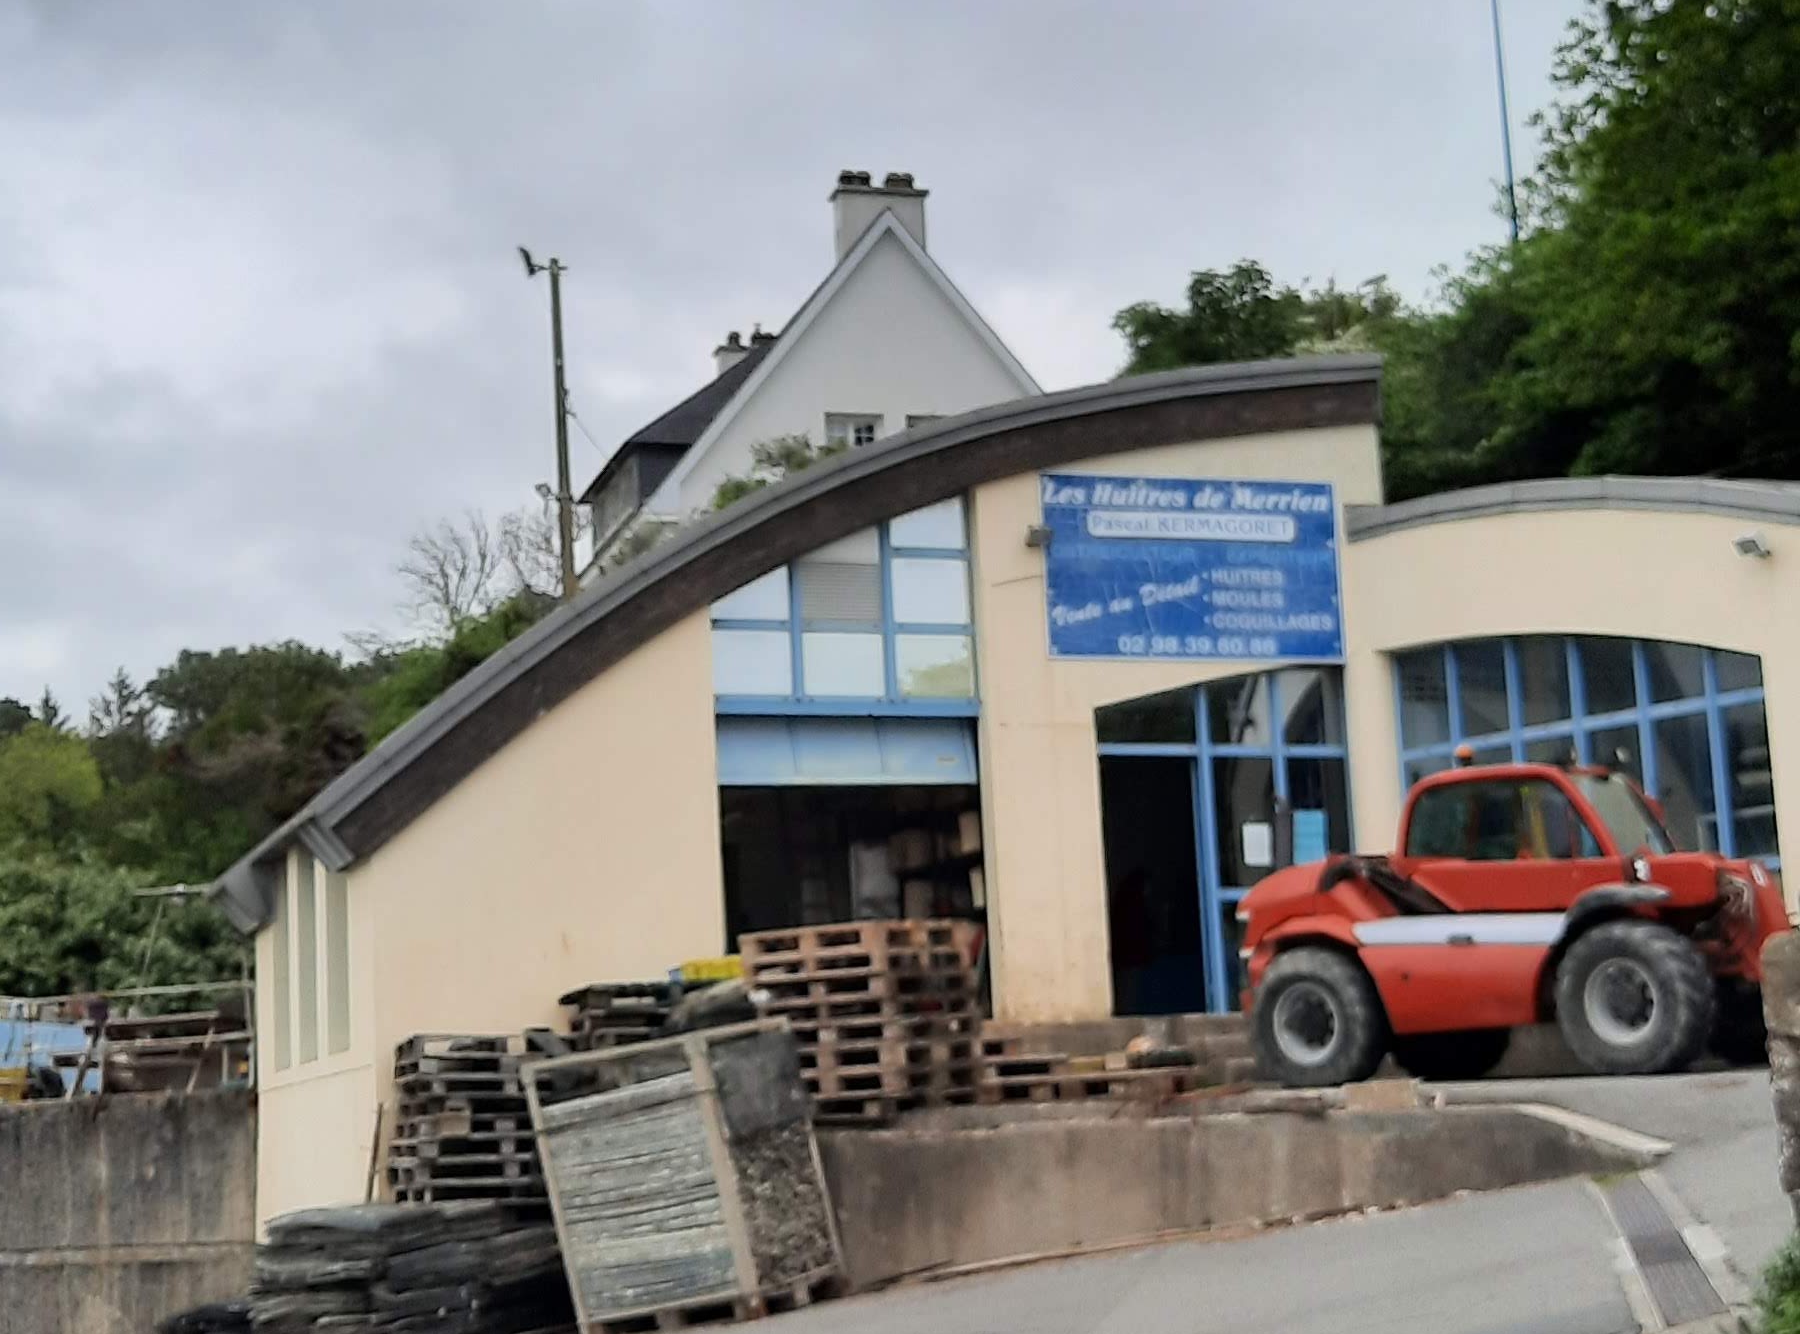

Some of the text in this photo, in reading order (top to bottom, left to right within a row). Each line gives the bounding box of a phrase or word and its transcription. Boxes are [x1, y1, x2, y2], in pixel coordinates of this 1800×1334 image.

[1043, 478, 1086, 505] Les
[1192, 484, 1224, 509] de
[1230, 486, 1328, 512] Merrien
[1212, 613, 1333, 631] COQUILLAGES
